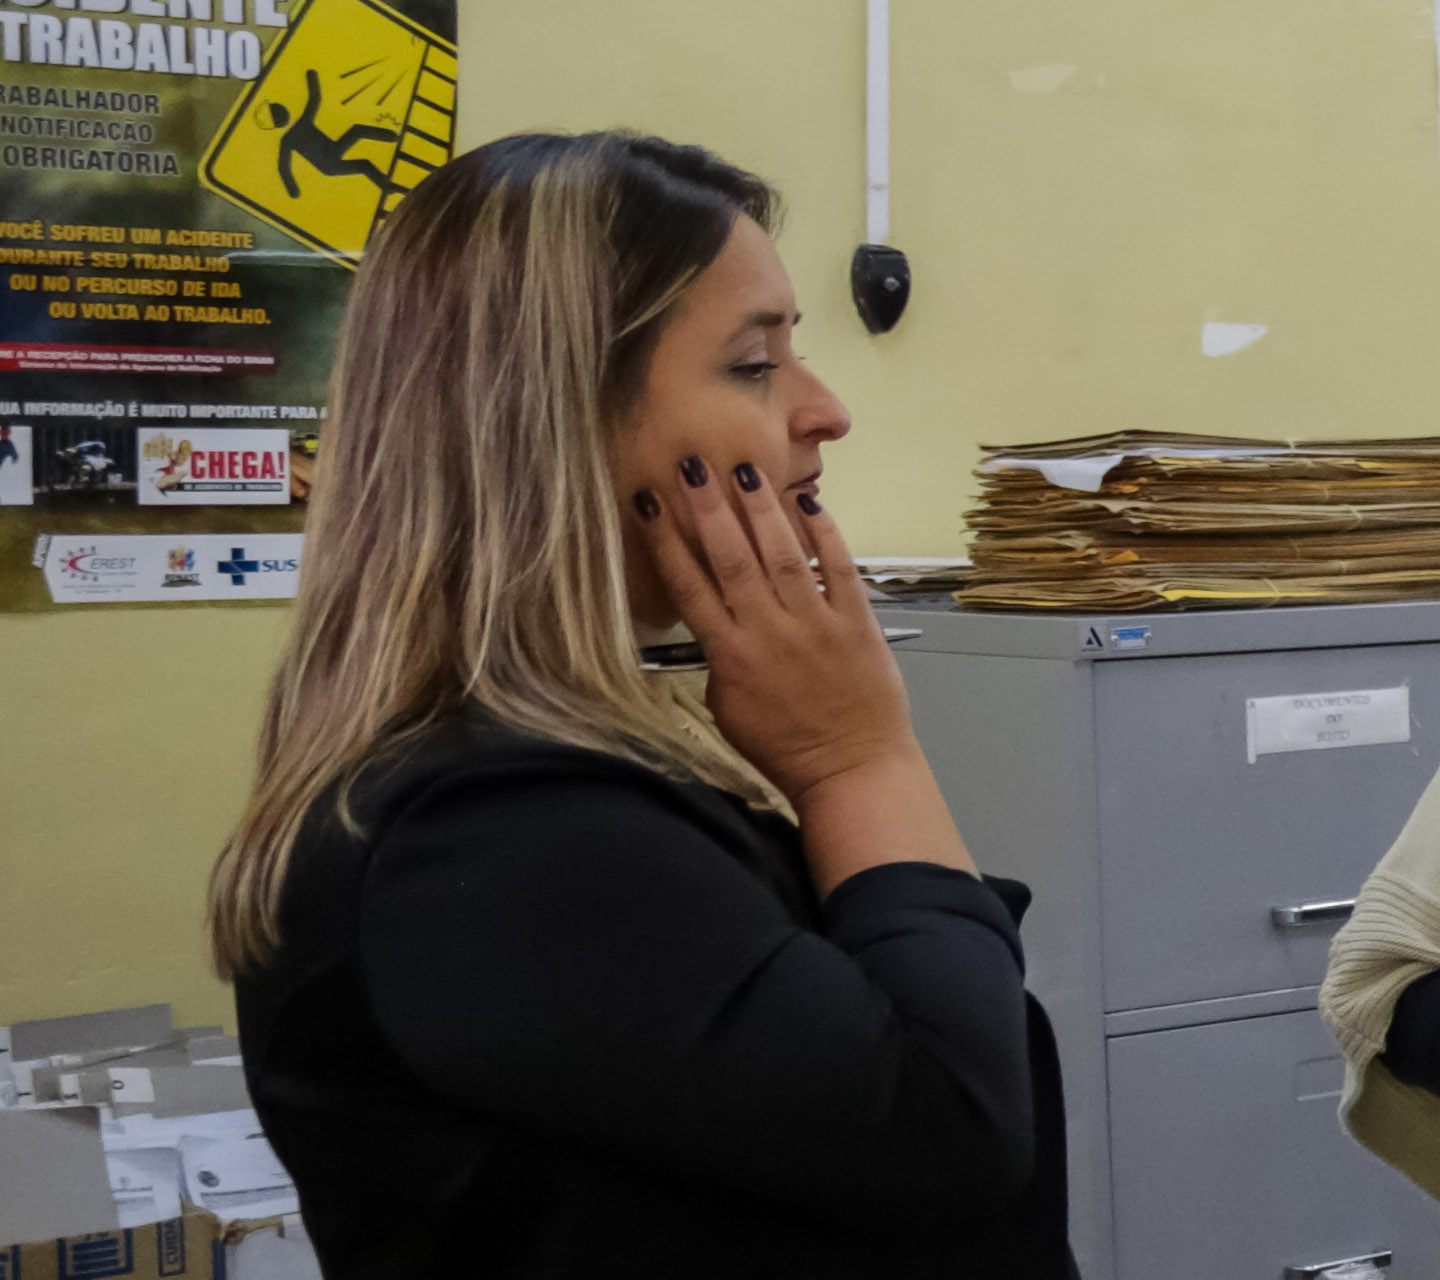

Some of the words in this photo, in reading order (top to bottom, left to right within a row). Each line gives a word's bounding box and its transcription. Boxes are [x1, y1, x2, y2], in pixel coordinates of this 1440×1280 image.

[0, 10, 262, 80] TRABALHO
[3, 144, 179, 175] OBRIGATÓRIA
[49, 224, 126, 244] SOFREU
[131, 227, 162, 245] UM
[165, 229, 254, 249] ACIDENTE
[90, 250, 128, 269] SEU
[132, 253, 231, 272] TRABALHO
[9, 273, 37, 291] OU
[43, 274, 70, 292] NO
[75, 276, 178, 296] PERCURSO
[182, 280, 206, 297] DE
[211, 282, 241, 299] IDA
[49, 301, 77, 319] OU
[81, 302, 139, 321] VOLTA
[145, 304, 170, 321] AO
[24, 400, 125, 420] INFORMAÇÃO
[141, 404, 187, 418] MUITO
[190, 404, 278, 419] IMPORTANTE
[280, 406, 316, 420] PARA
[191, 450, 286, 479] CHEGA!
[261, 559, 298, 572] SUS
